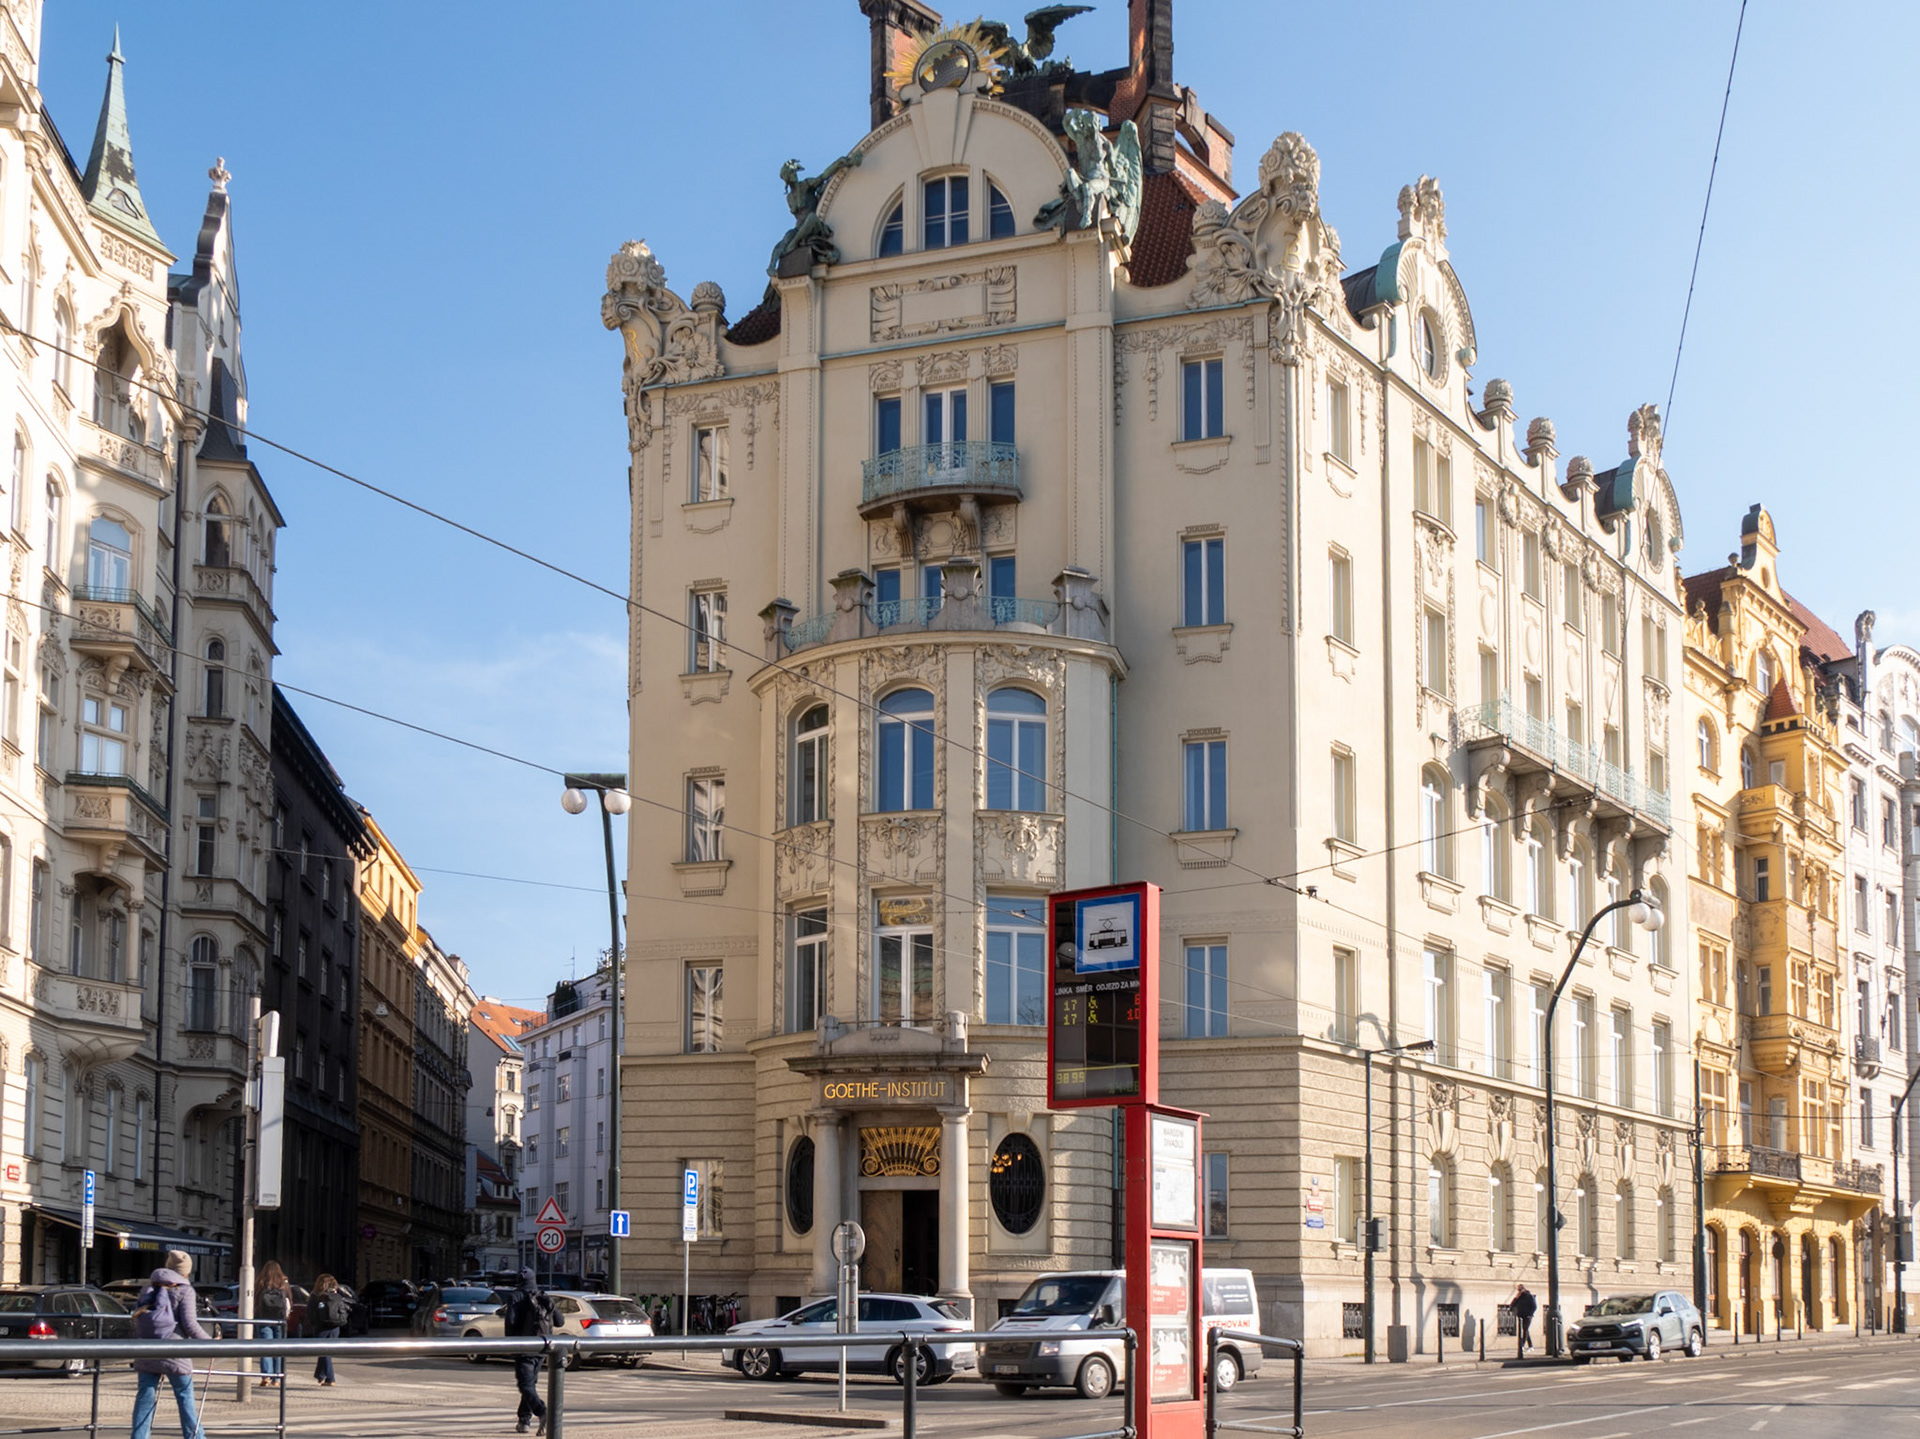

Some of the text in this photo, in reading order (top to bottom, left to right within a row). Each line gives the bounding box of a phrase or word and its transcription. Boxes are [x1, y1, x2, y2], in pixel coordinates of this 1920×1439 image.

[1055, 986, 1073, 996] LINKA
[1095, 982, 1120, 992] ODJEZD
[1120, 981, 1129, 989] ZA
[1063, 999, 1078, 1012] 17
[1063, 1013, 1078, 1026] 17
[824, 1081, 946, 1099] GOETHE-INSTITUT
[687, 1174, 696, 1195] P
[543, 1233, 559, 1246] 20
